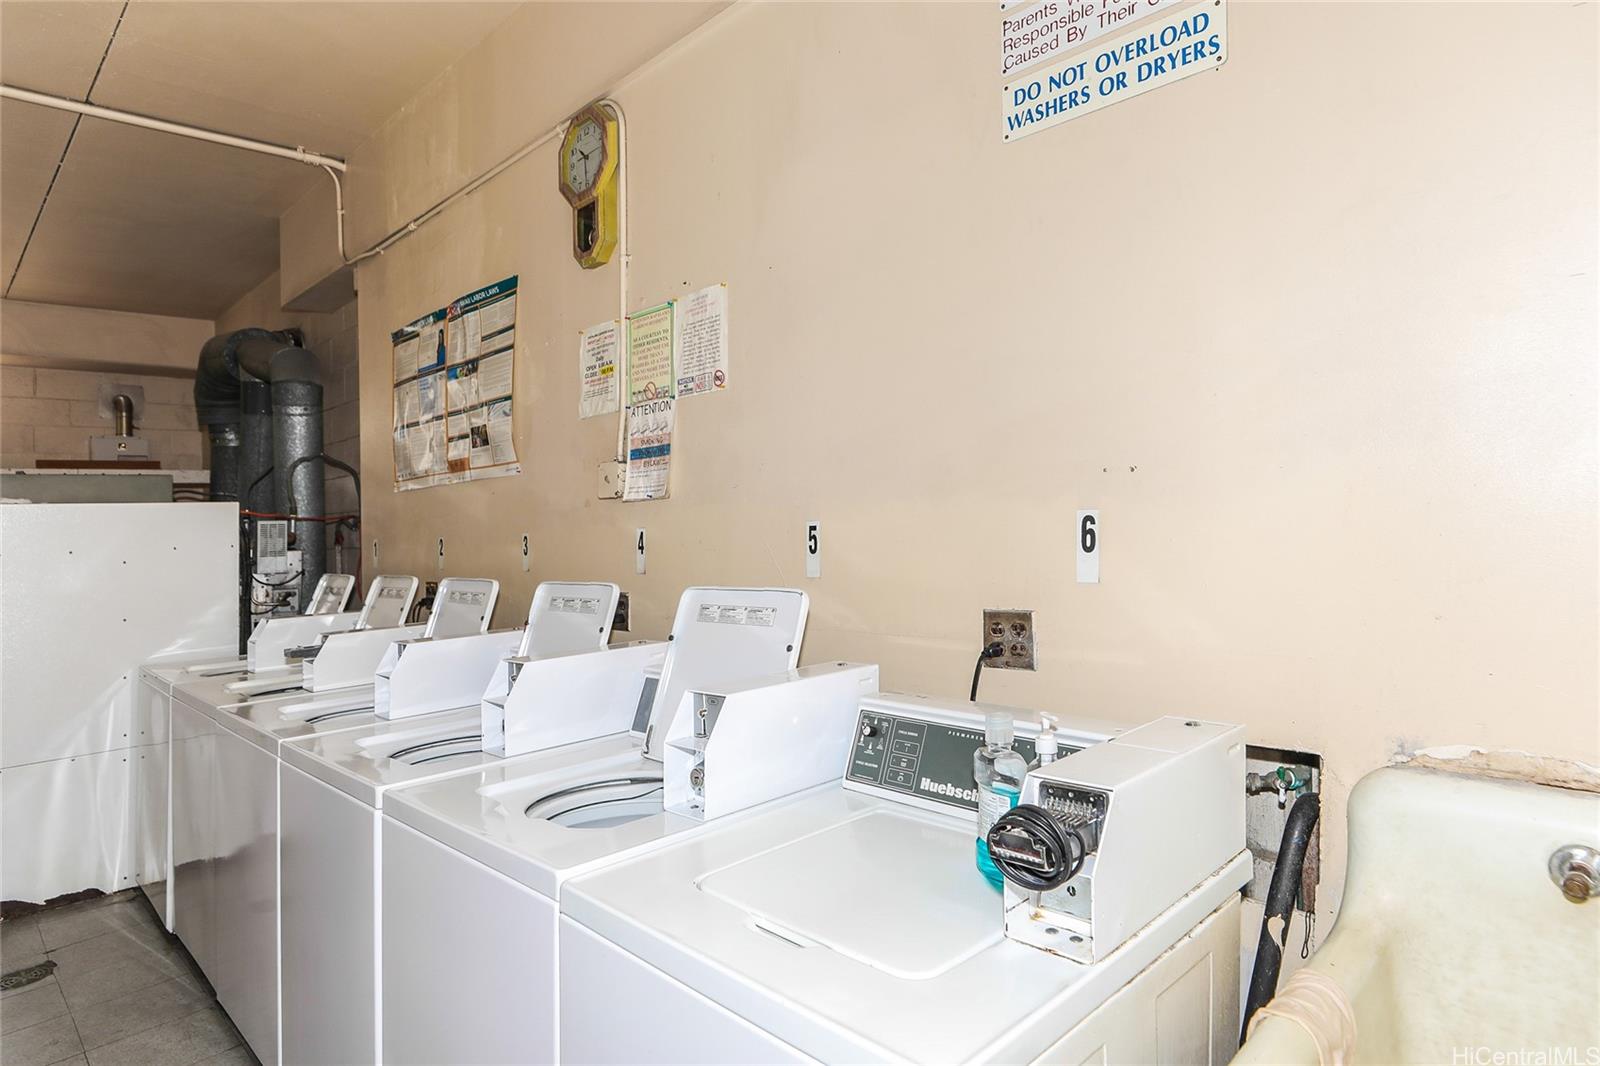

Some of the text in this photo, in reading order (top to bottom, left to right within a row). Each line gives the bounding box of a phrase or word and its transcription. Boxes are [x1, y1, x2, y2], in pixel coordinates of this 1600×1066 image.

[1003, 3, 1058, 37] Parents
[1003, 4, 1094, 54] Responsible
[1004, 2, 1138, 71] Caused By Their
[1013, 12, 1210, 107] DO NOT OVERLOAD
[1007, 34, 1221, 132] WASHERS OR DRYERS
[485, 286, 500, 297] LAWS
[631, 400, 672, 418] ATTENTION
[522, 535, 529, 556] 3
[637, 531, 645, 555] 4
[808, 525, 818, 555] 5
[1081, 514, 1097, 554] 6
[373, 541, 378, 557] 1
[438, 538, 444, 557] 2
[947, 730, 984, 741] PERMANEN
[920, 777, 979, 803] Huebsch
